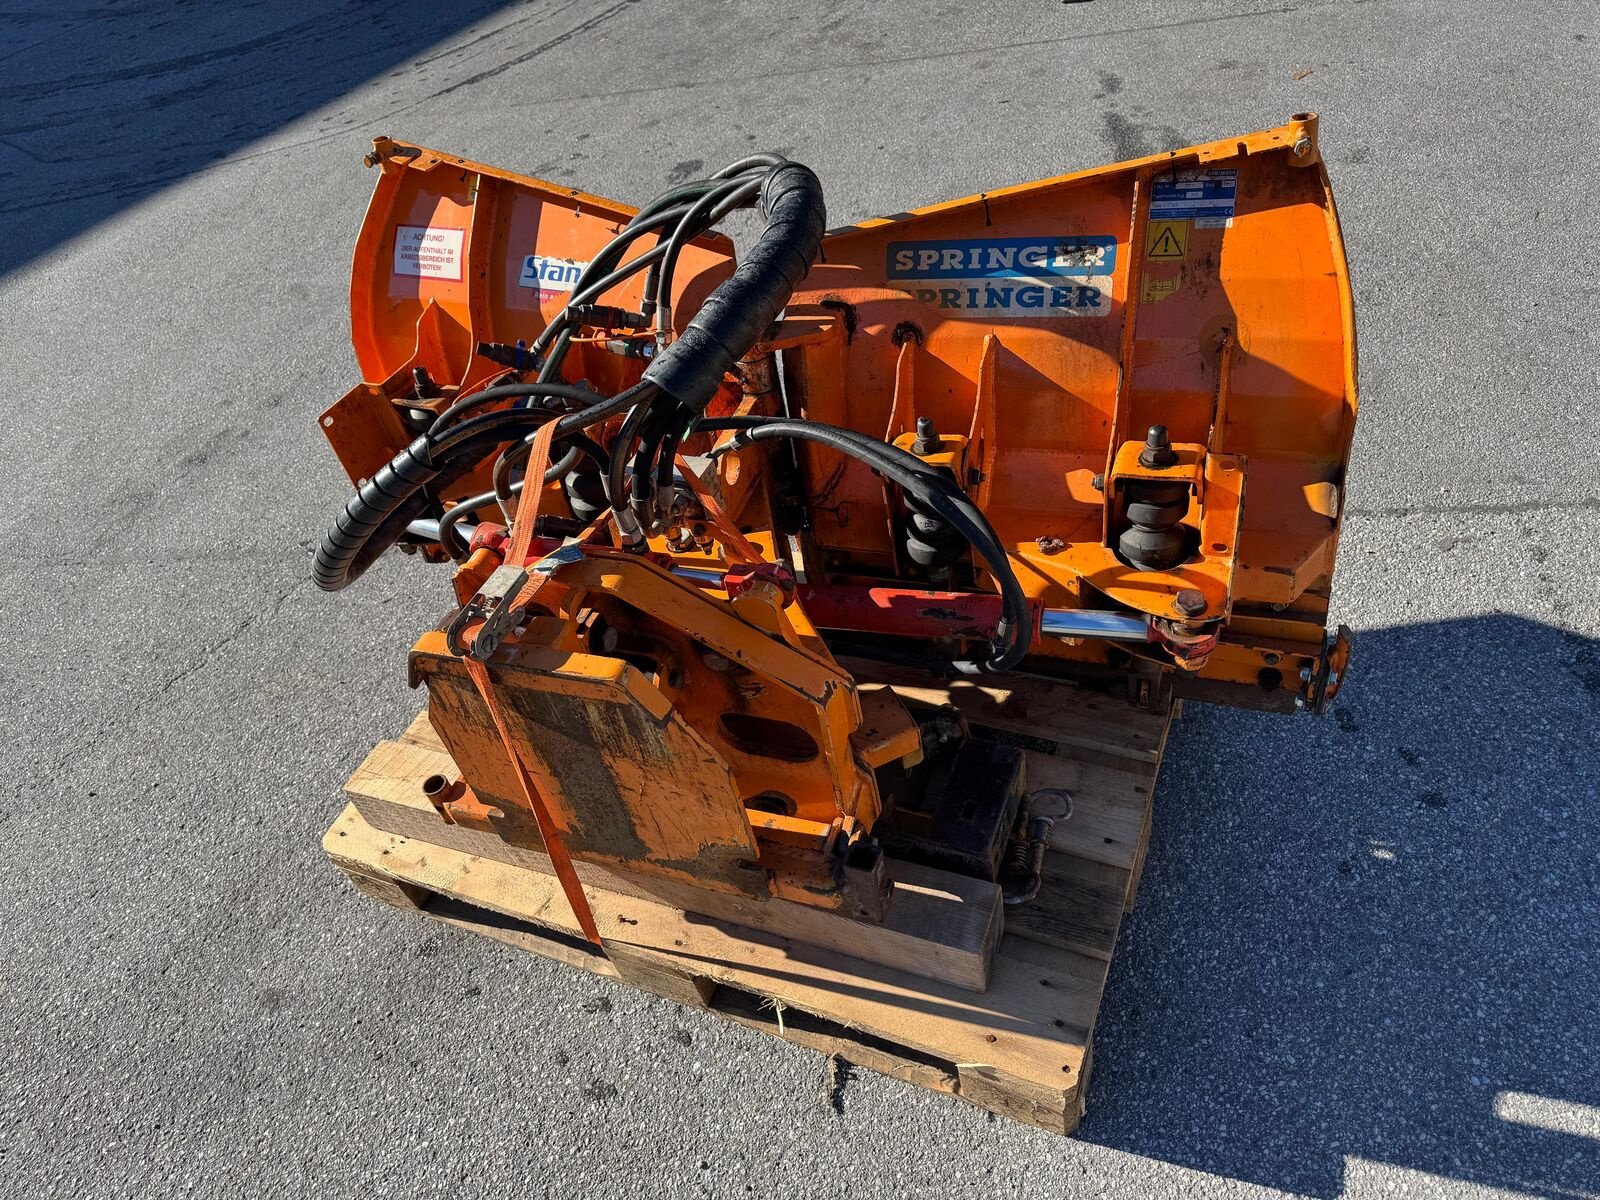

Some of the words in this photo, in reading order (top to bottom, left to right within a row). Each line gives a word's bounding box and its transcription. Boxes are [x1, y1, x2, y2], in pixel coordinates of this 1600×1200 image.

[413, 233, 445, 242] ACHTUNG!
[413, 246, 447, 255] AUFENTHALT
[400, 254, 445, 263] ARBEITSBEREICH
[895, 246, 1105, 271] SPRINGER
[412, 262, 442, 271] VERBOTEN!
[524, 256, 582, 284] Stan
[915, 286, 1102, 309] PRINGER
